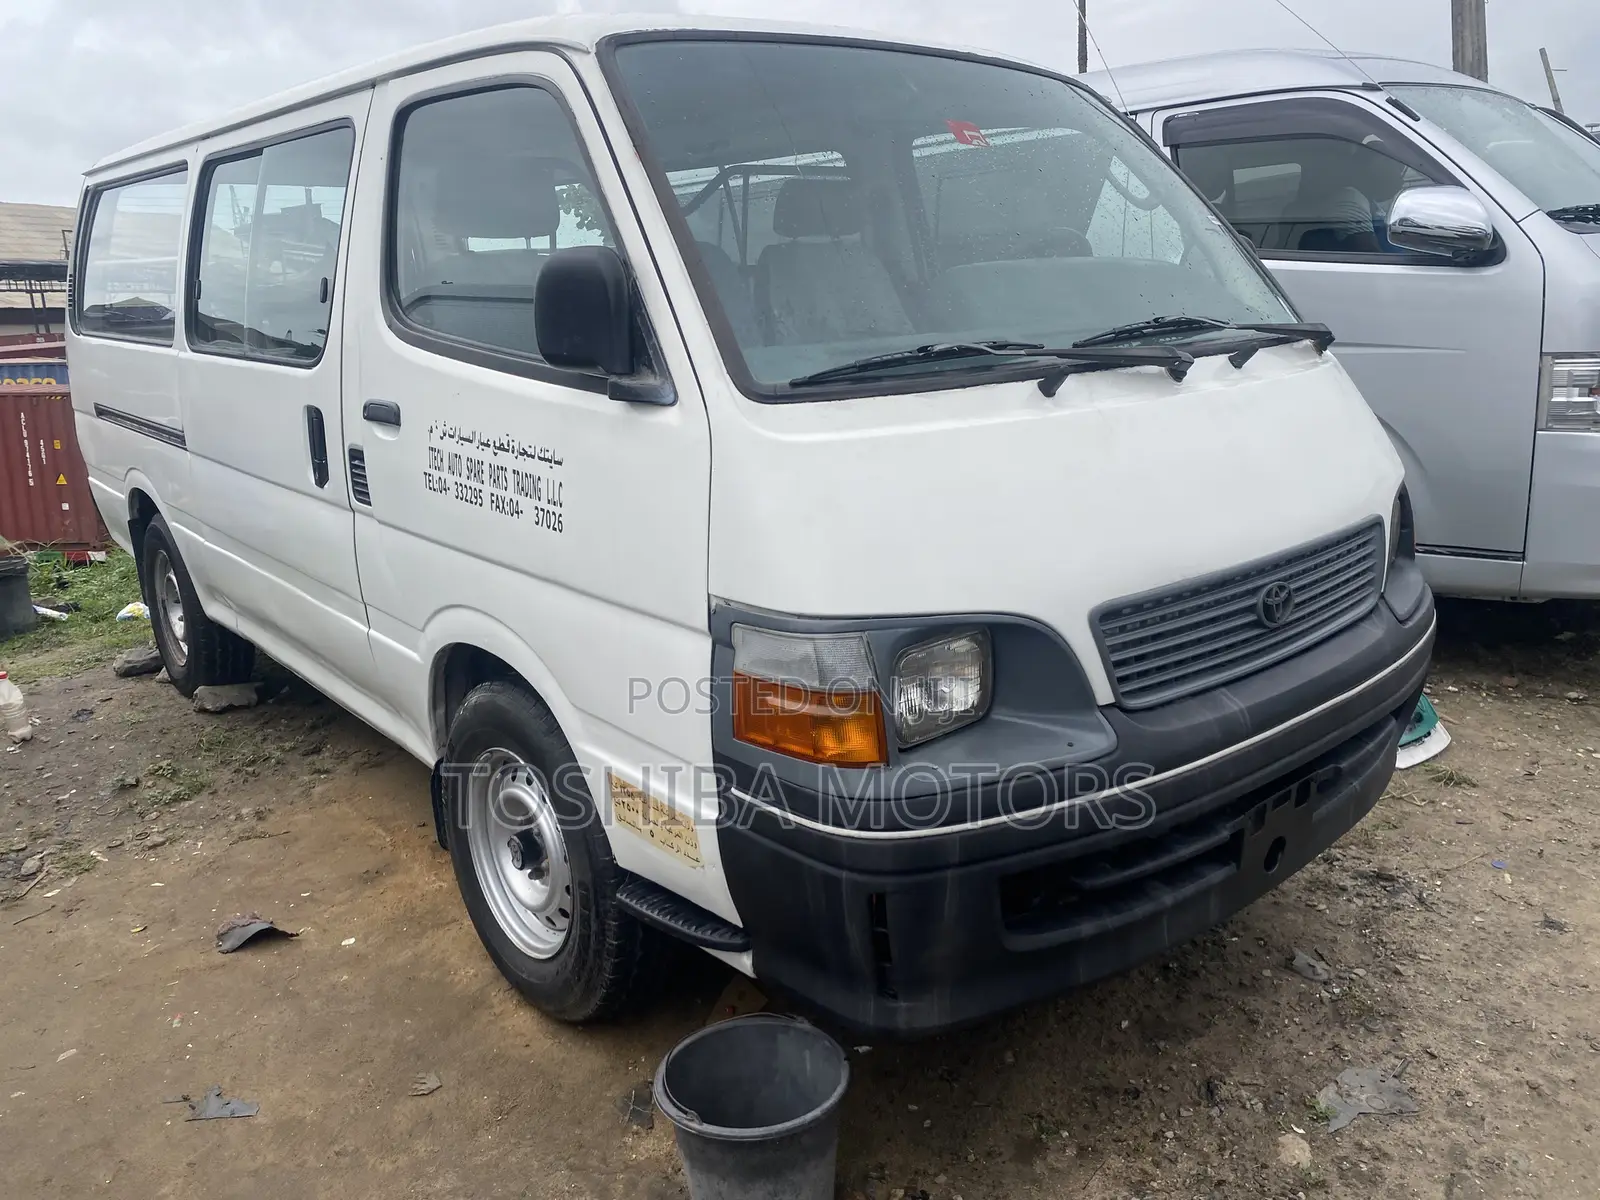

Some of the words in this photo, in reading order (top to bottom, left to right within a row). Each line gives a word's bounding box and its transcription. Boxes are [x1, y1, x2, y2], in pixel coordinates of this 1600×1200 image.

[448, 426, 476, 446] السيارات
[493, 433, 510, 456] قطع
[448, 452, 462, 478] AUTO
[466, 457, 484, 485] SPARE
[489, 463, 508, 491] PARTS
[512, 469, 542, 502] TRADING
[454, 481, 483, 507] 332295
[534, 506, 563, 533] 37026
